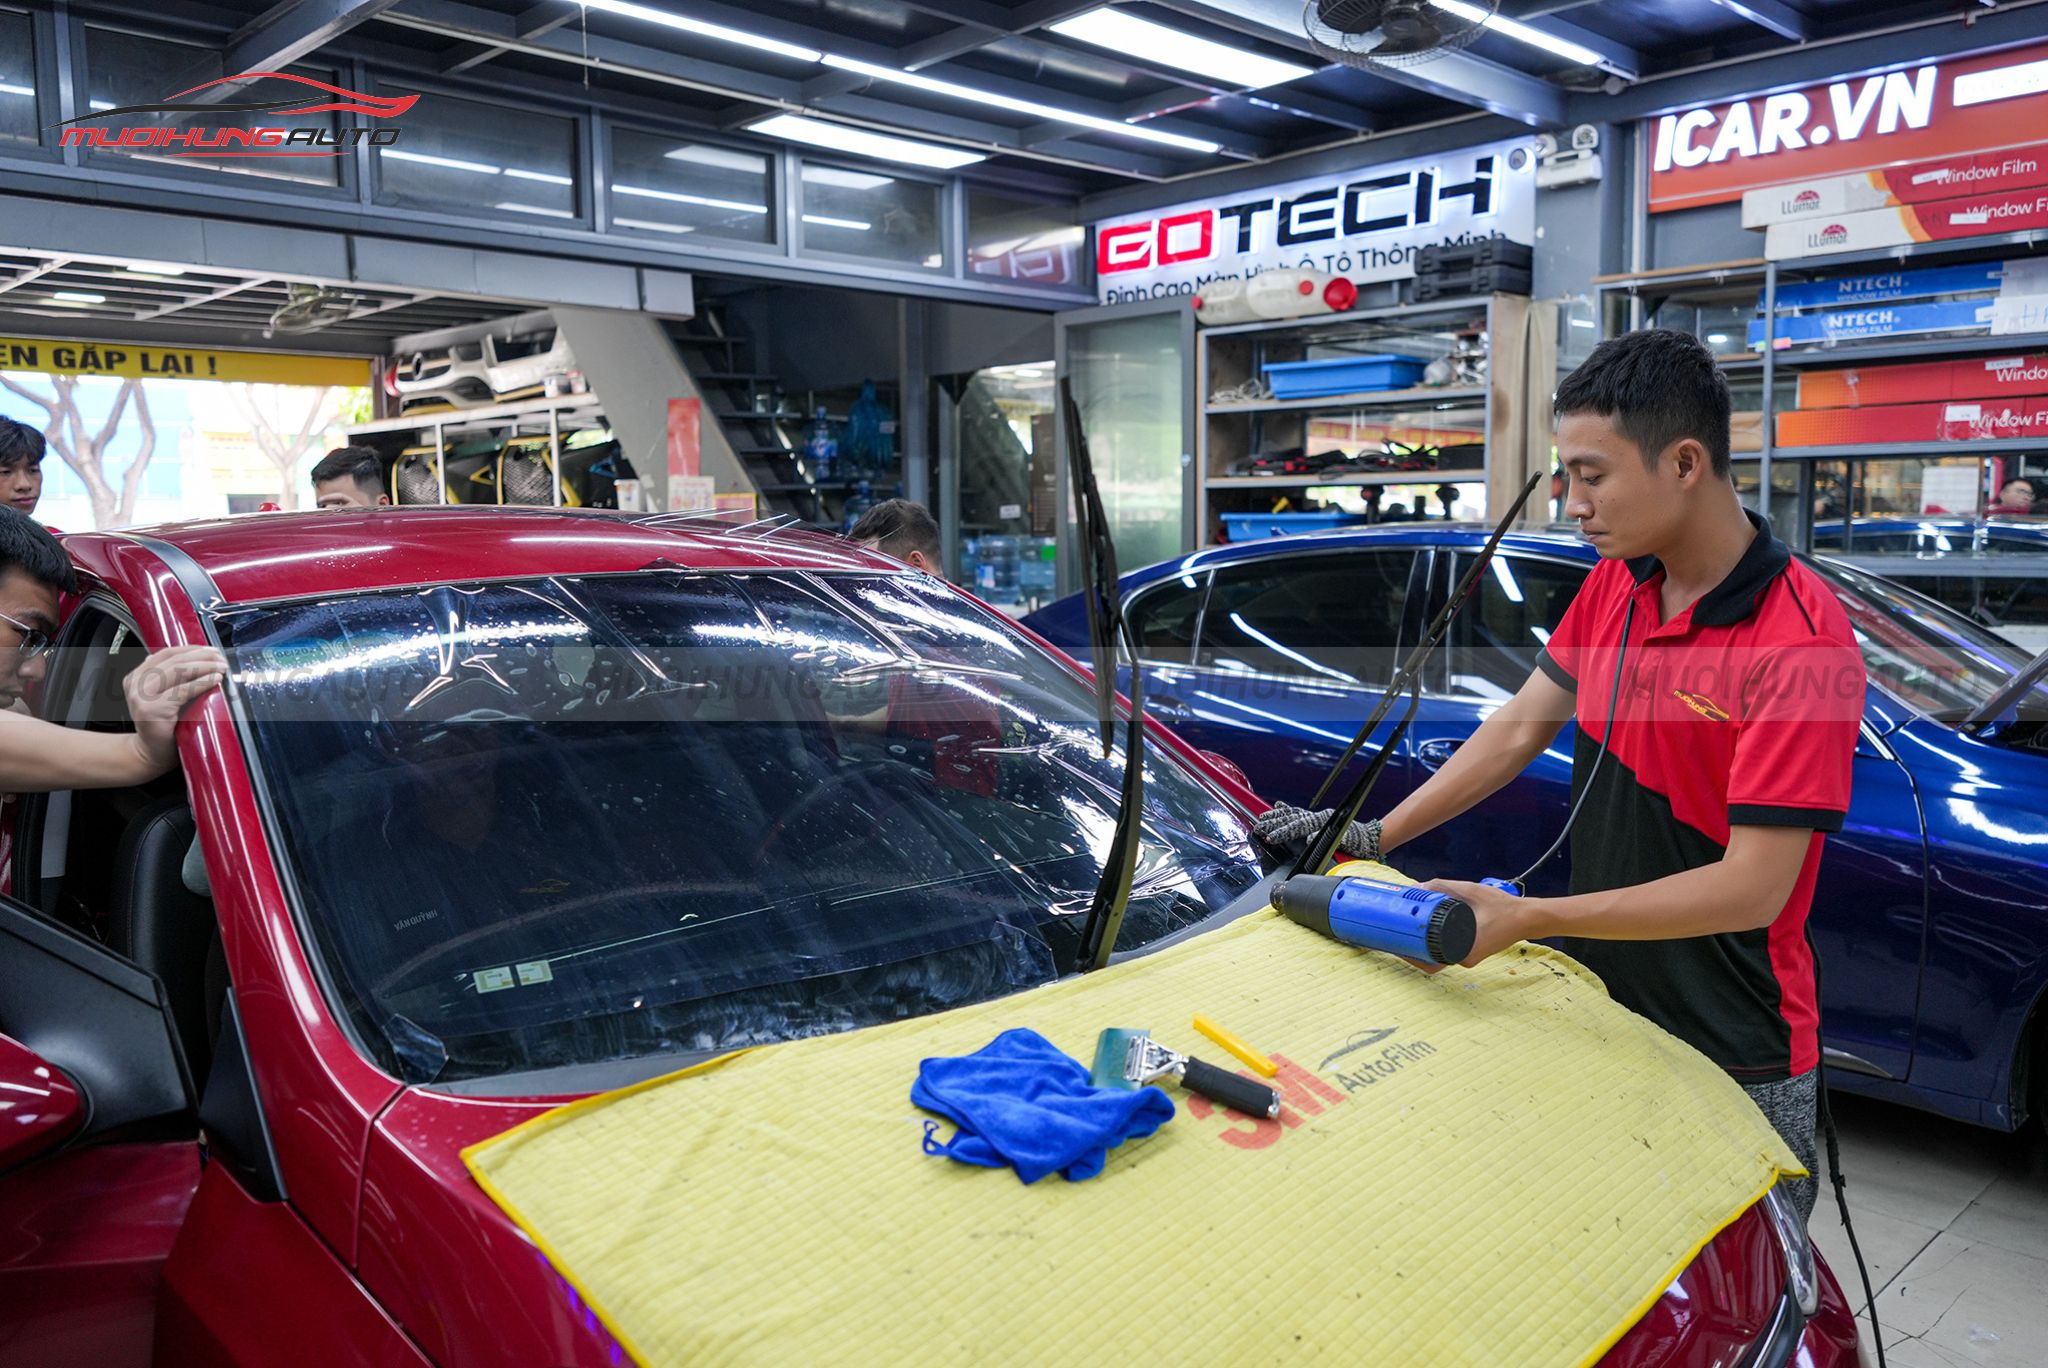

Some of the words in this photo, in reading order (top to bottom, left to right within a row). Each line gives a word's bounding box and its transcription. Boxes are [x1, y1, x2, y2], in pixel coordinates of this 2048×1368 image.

[1653, 65, 1938, 172] ICAR.VN
[1937, 164, 1999, 185] Window
[2002, 159, 2037, 176] Film
[1097, 155, 1502, 277] GOTECH
[1152, 281, 1193, 300] Cao
[1323, 250, 1351, 273] Tô
[1357, 242, 1438, 270] Thôn
[1839, 276, 1902, 292] NTECH
[1828, 311, 1893, 328] NTECH
[53, 345, 126, 374] GẶP
[140, 353, 193, 378] LẠI
[1334, 1037, 1439, 1094] AutoFilm
